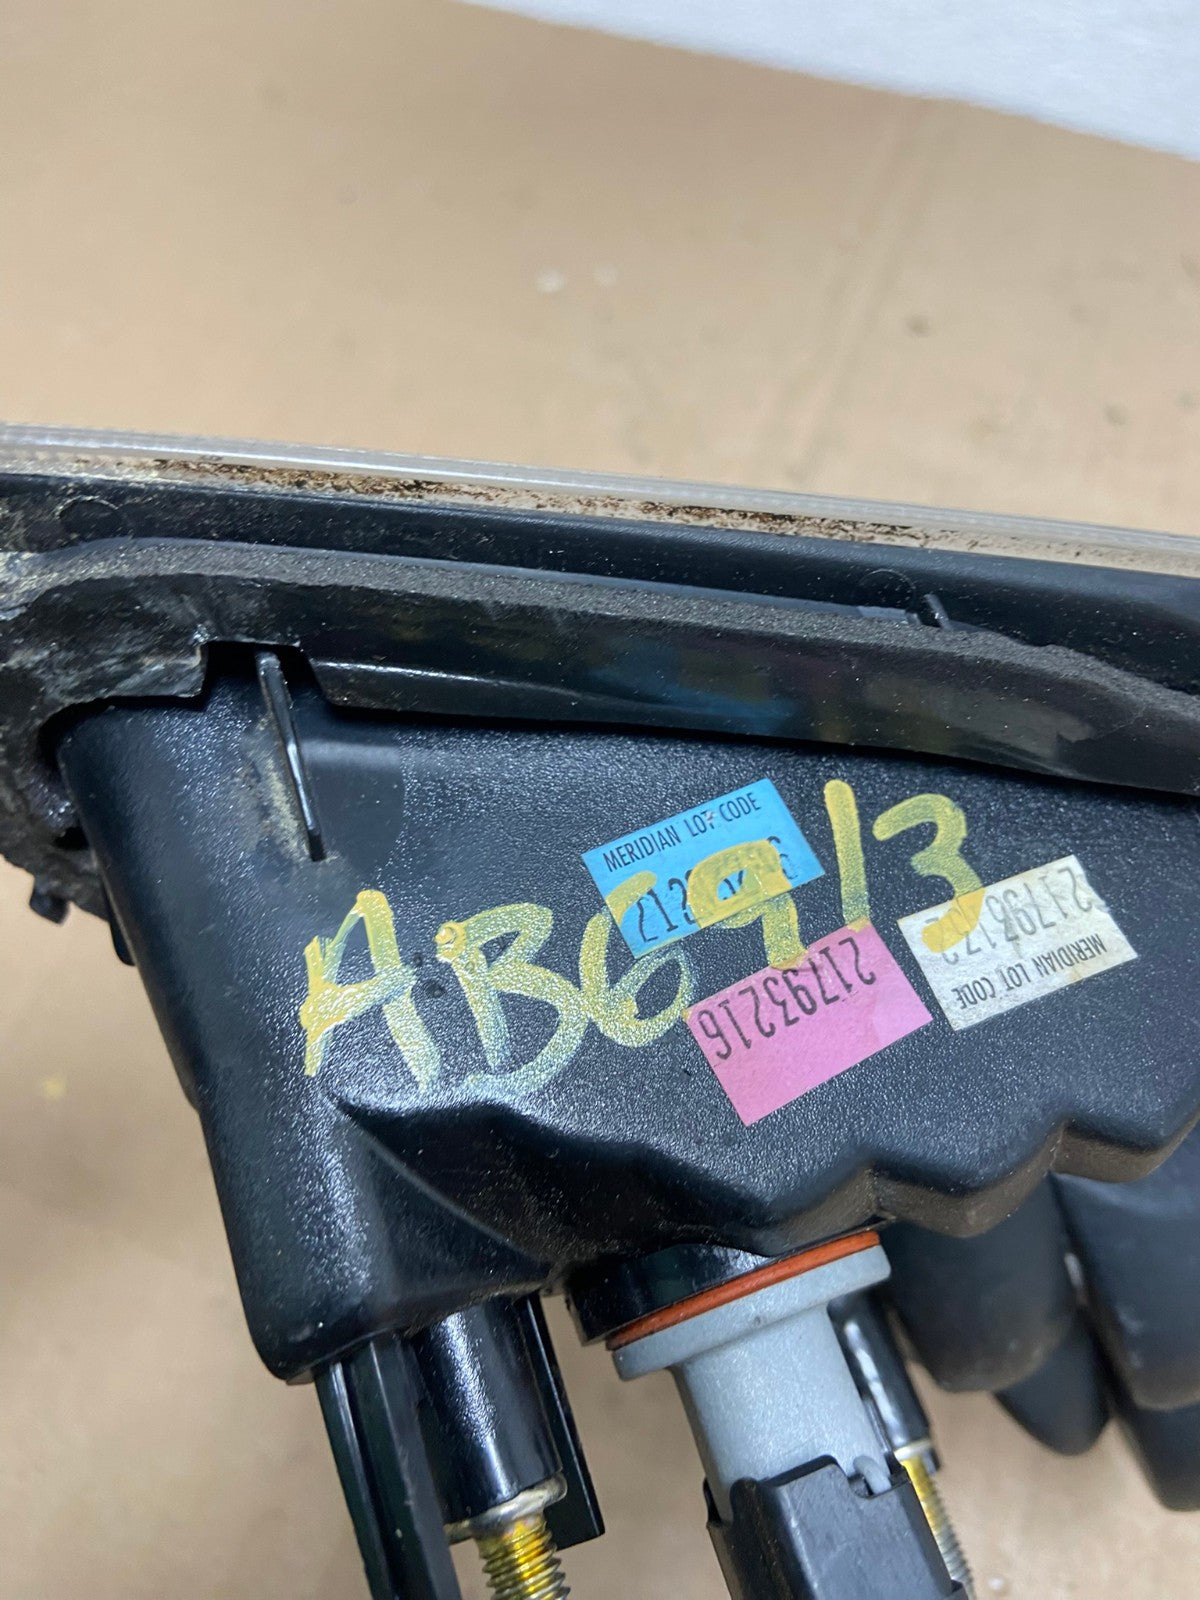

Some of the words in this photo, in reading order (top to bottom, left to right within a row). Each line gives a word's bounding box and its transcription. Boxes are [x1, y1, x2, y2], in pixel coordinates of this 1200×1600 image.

[602, 825, 682, 873] MERIDIAN
[684, 809, 716, 838] LOT
[718, 792, 762, 823] CODE
[1000, 961, 1032, 990] LOT
[1032, 932, 1108, 978] MERIDIAN
[698, 937, 877, 1060] 21793216
[951, 976, 996, 1010] CODE
